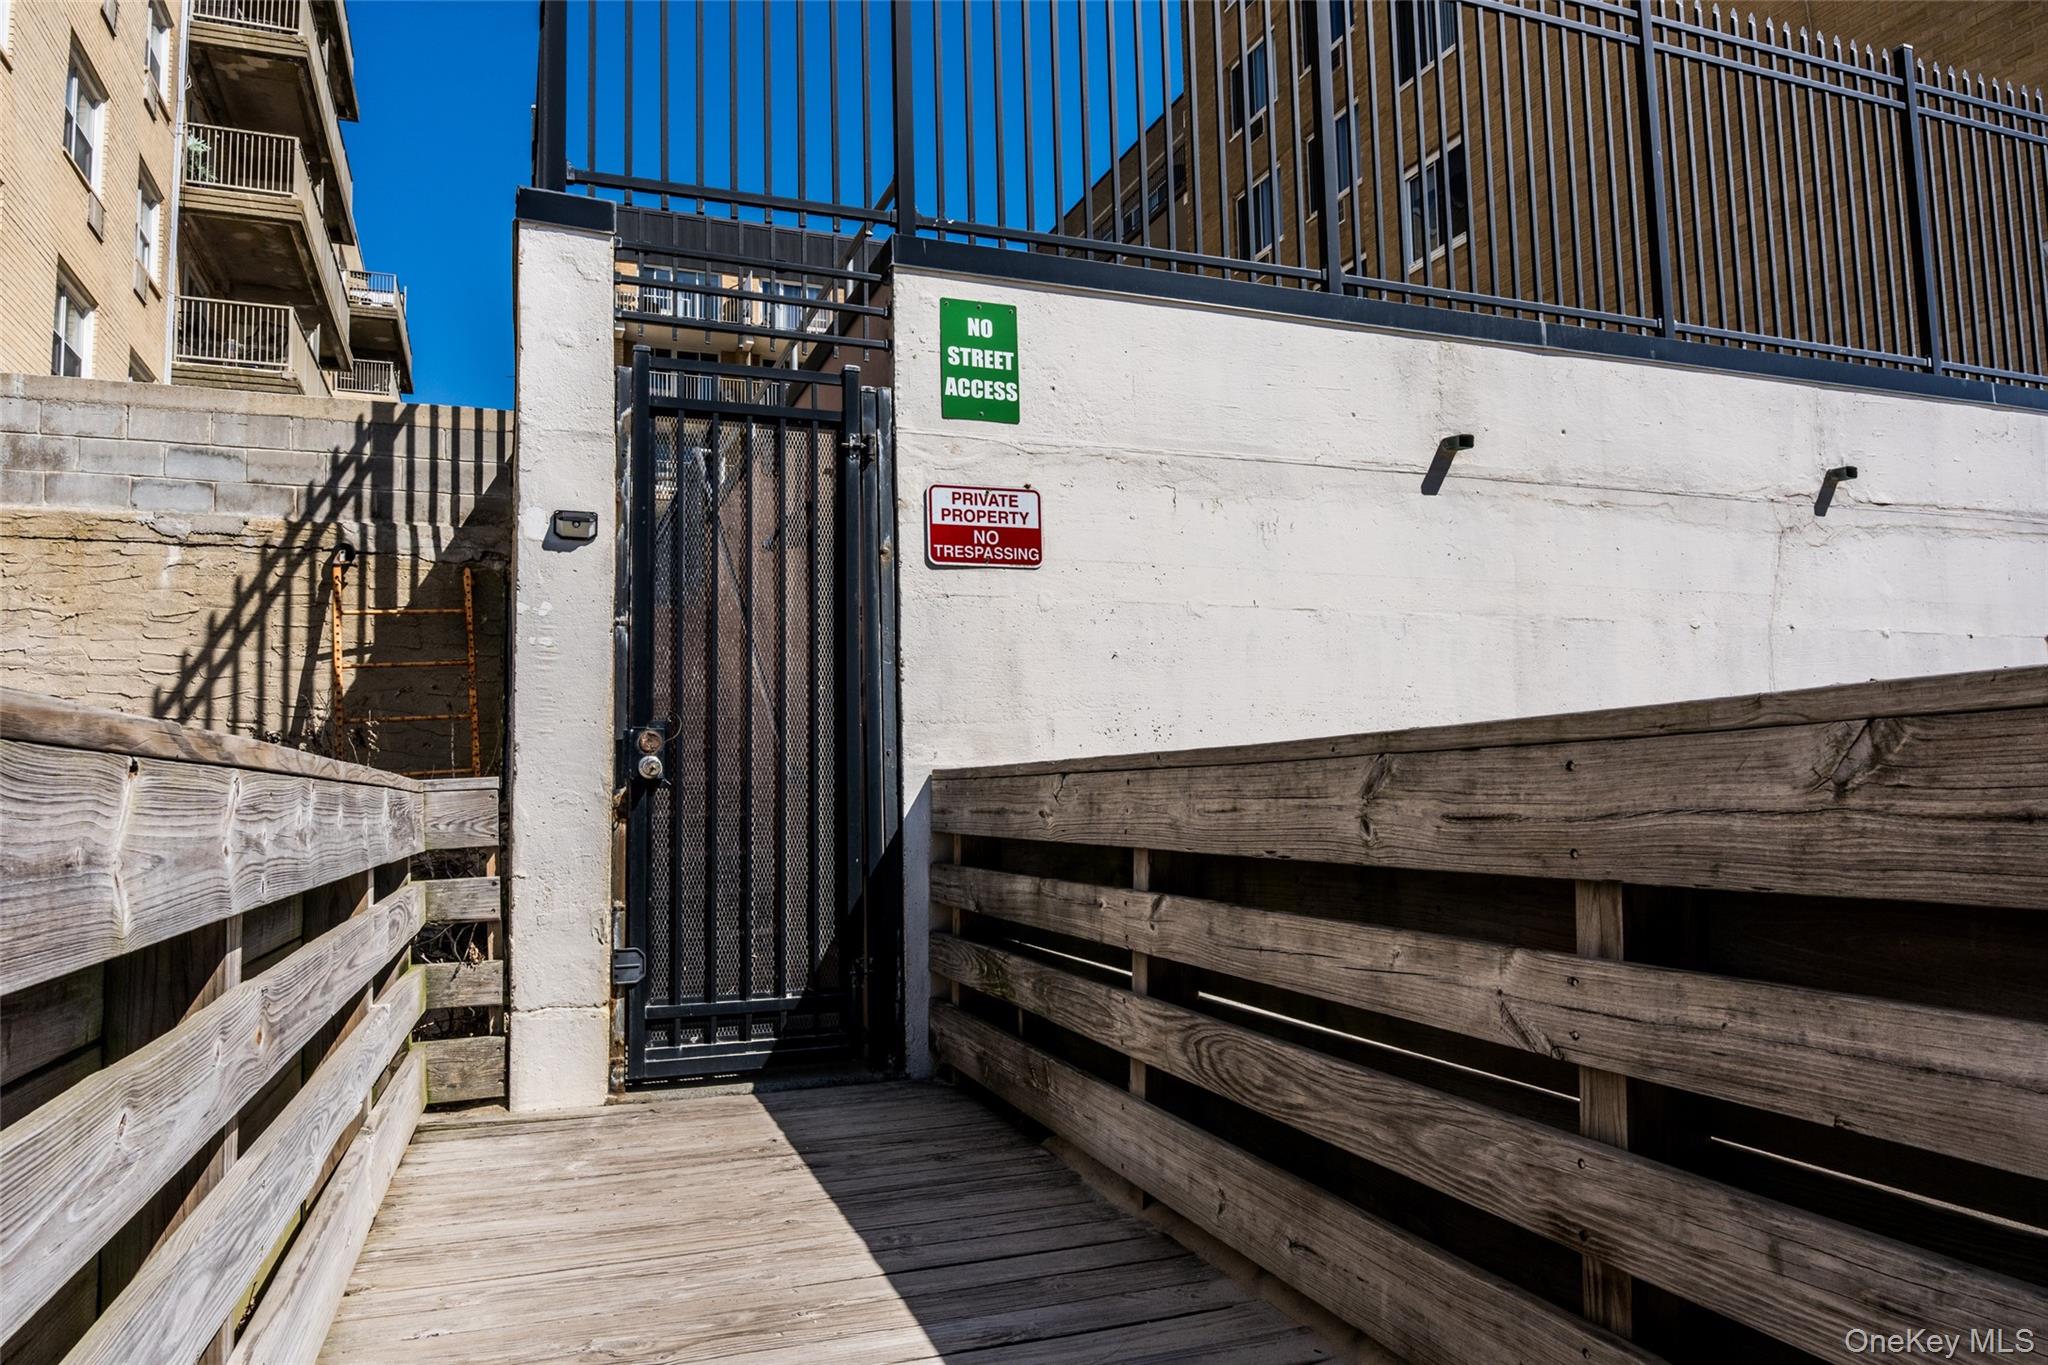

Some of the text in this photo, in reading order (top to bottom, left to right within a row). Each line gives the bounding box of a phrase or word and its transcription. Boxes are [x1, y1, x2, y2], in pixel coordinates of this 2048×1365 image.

[967, 317, 993, 338] NO
[947, 346, 1014, 371] STREET
[945, 377, 1018, 402] ACCESS
[951, 491, 1018, 508] PRIVATE
[941, 508, 1029, 525] PROPERTY
[973, 530, 999, 545] NO
[933, 544, 1040, 561] TRESPASSING
